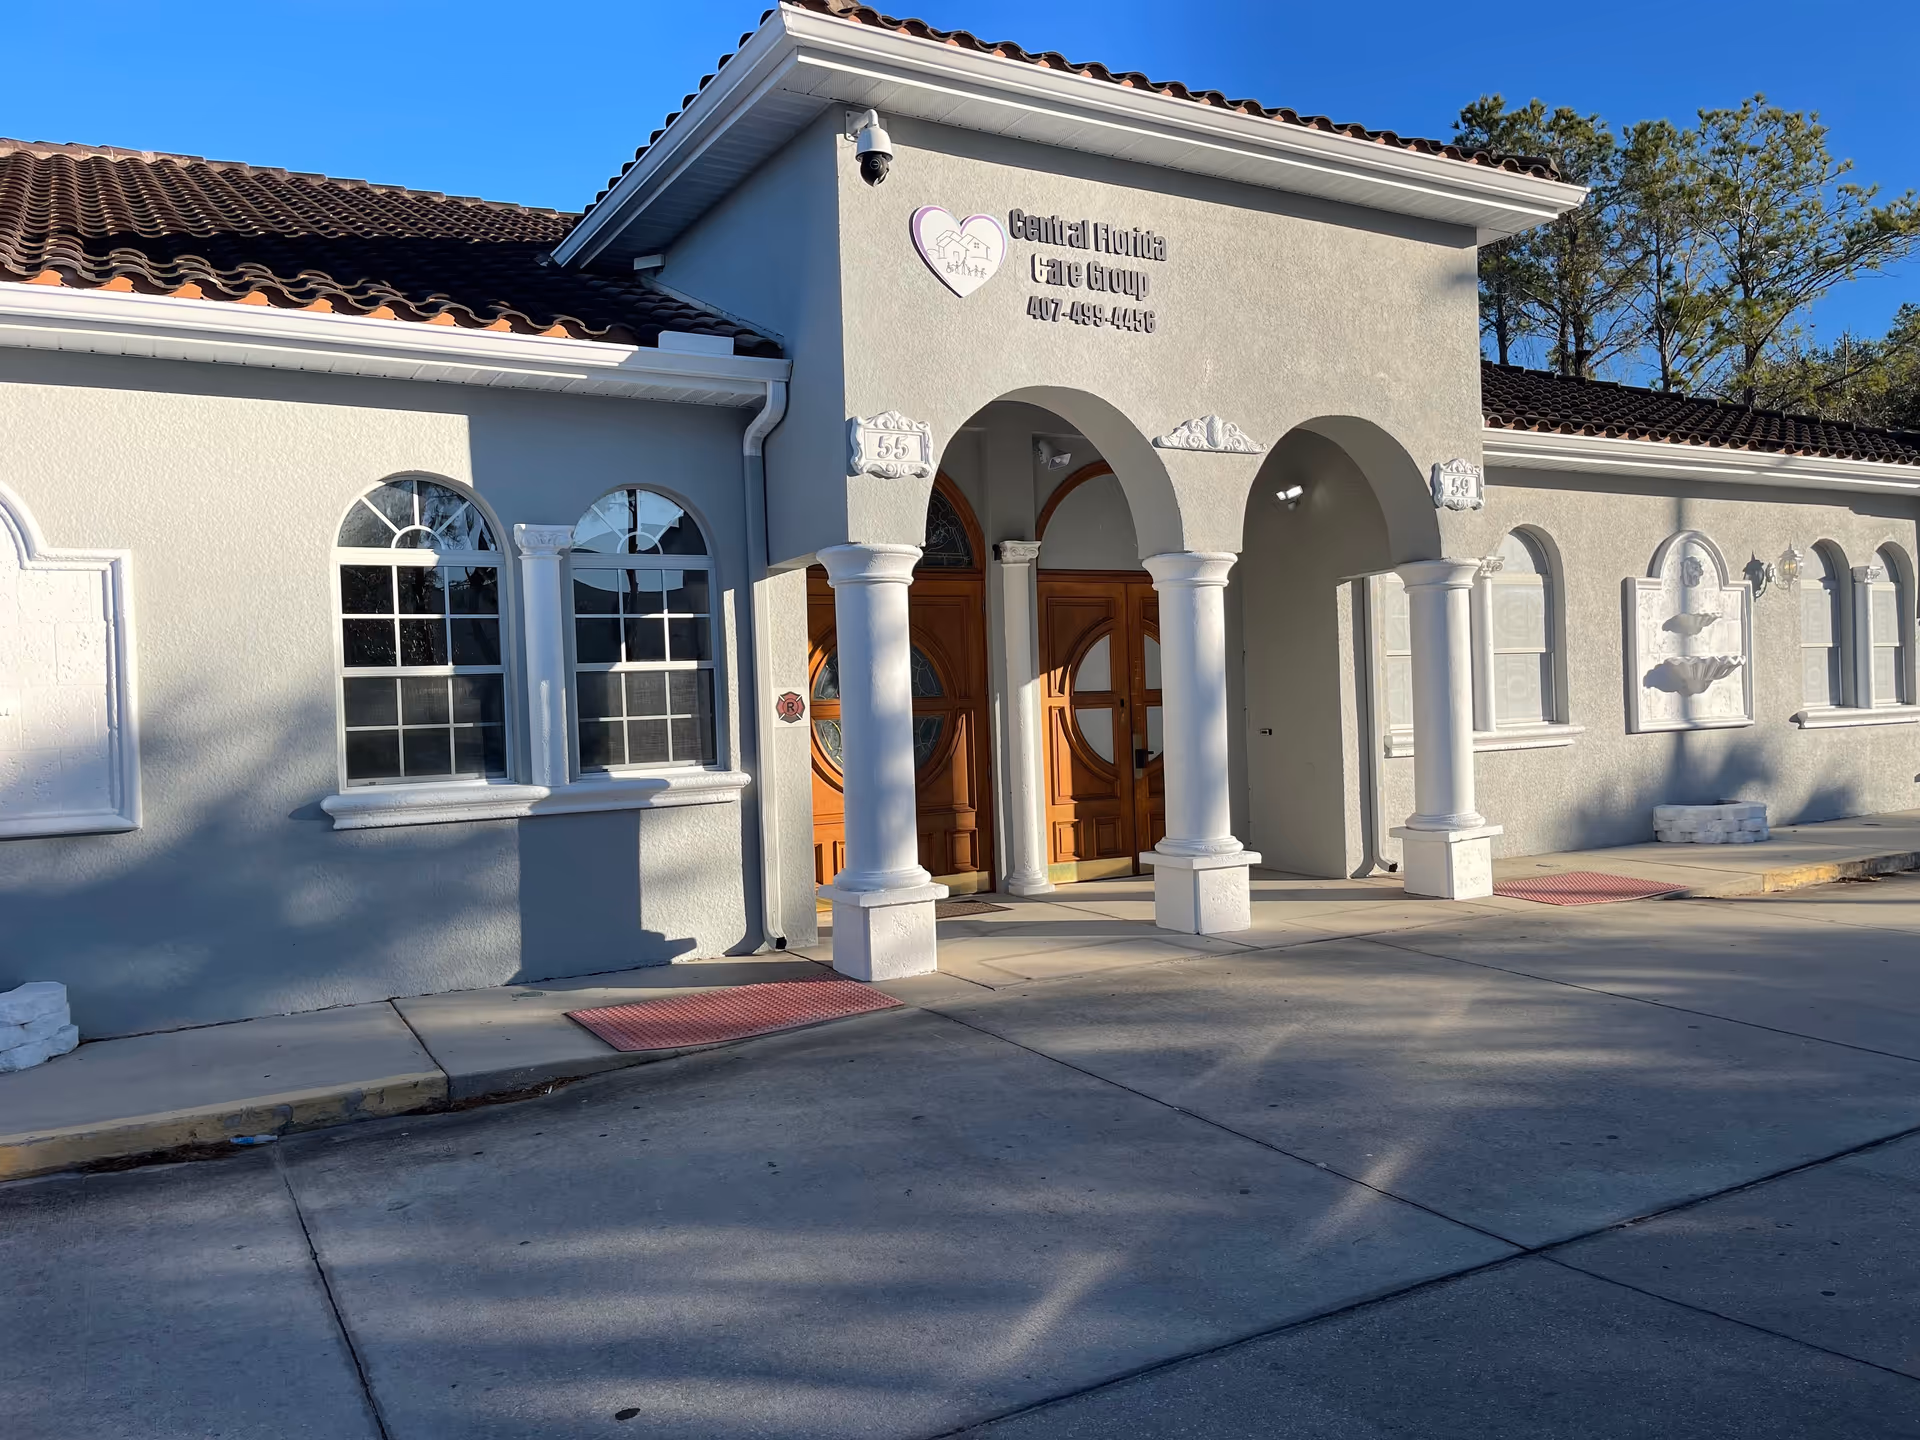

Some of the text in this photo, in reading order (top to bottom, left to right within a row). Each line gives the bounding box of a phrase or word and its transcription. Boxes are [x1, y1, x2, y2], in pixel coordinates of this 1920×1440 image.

[1009, 208, 1167, 261] Central Florida
[1031, 253, 1150, 301] Care Group
[1026, 296, 1156, 333] 407-499-4456
[877, 434, 909, 460] 55
[1451, 476, 1469, 497] 59
[786, 701, 795, 712] R
